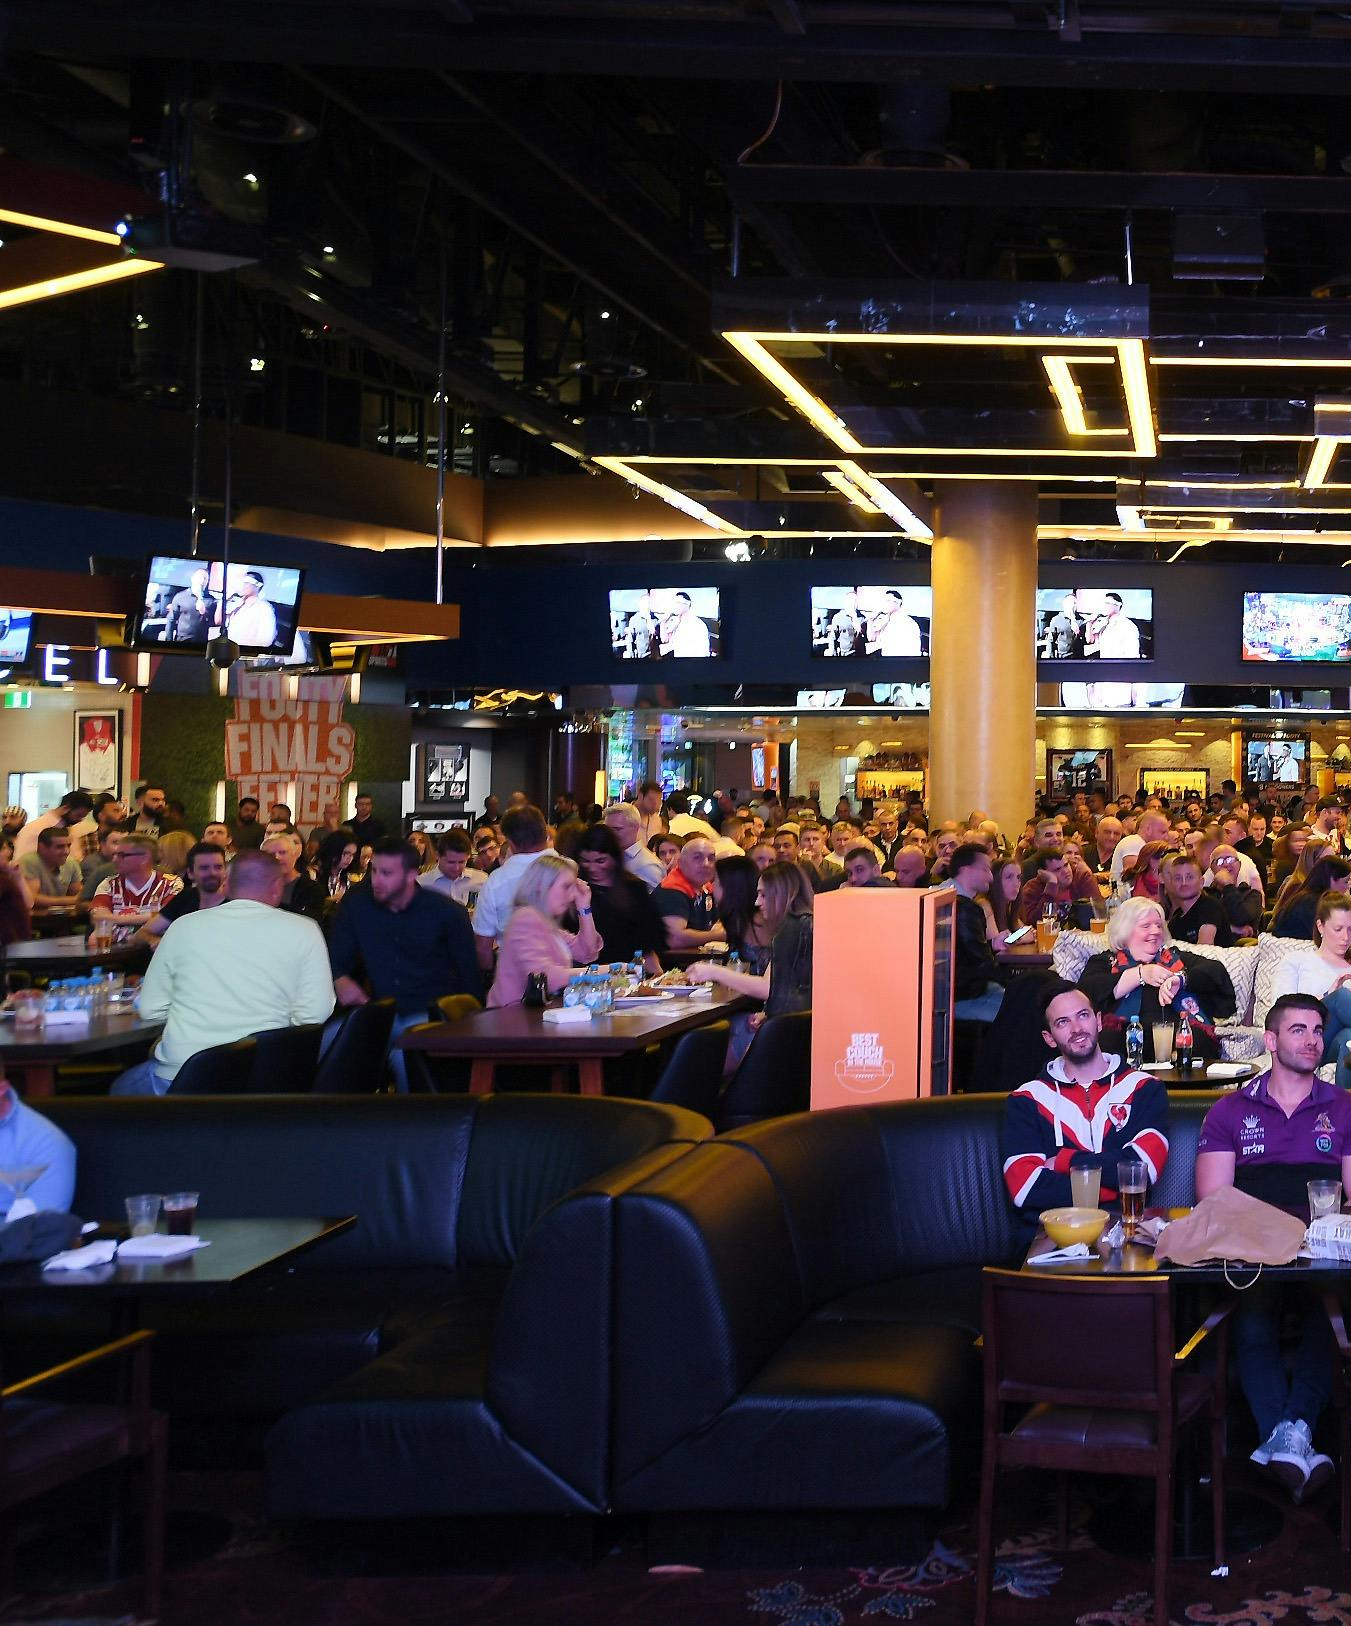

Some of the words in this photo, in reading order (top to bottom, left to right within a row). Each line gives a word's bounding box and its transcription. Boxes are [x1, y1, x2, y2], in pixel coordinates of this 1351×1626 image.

[228, 723, 351, 776] FINALS
[851, 1033, 879, 1046] BEST
[846, 1045, 884, 1058] COUCH
[1240, 1127, 1265, 1135] CROWN
